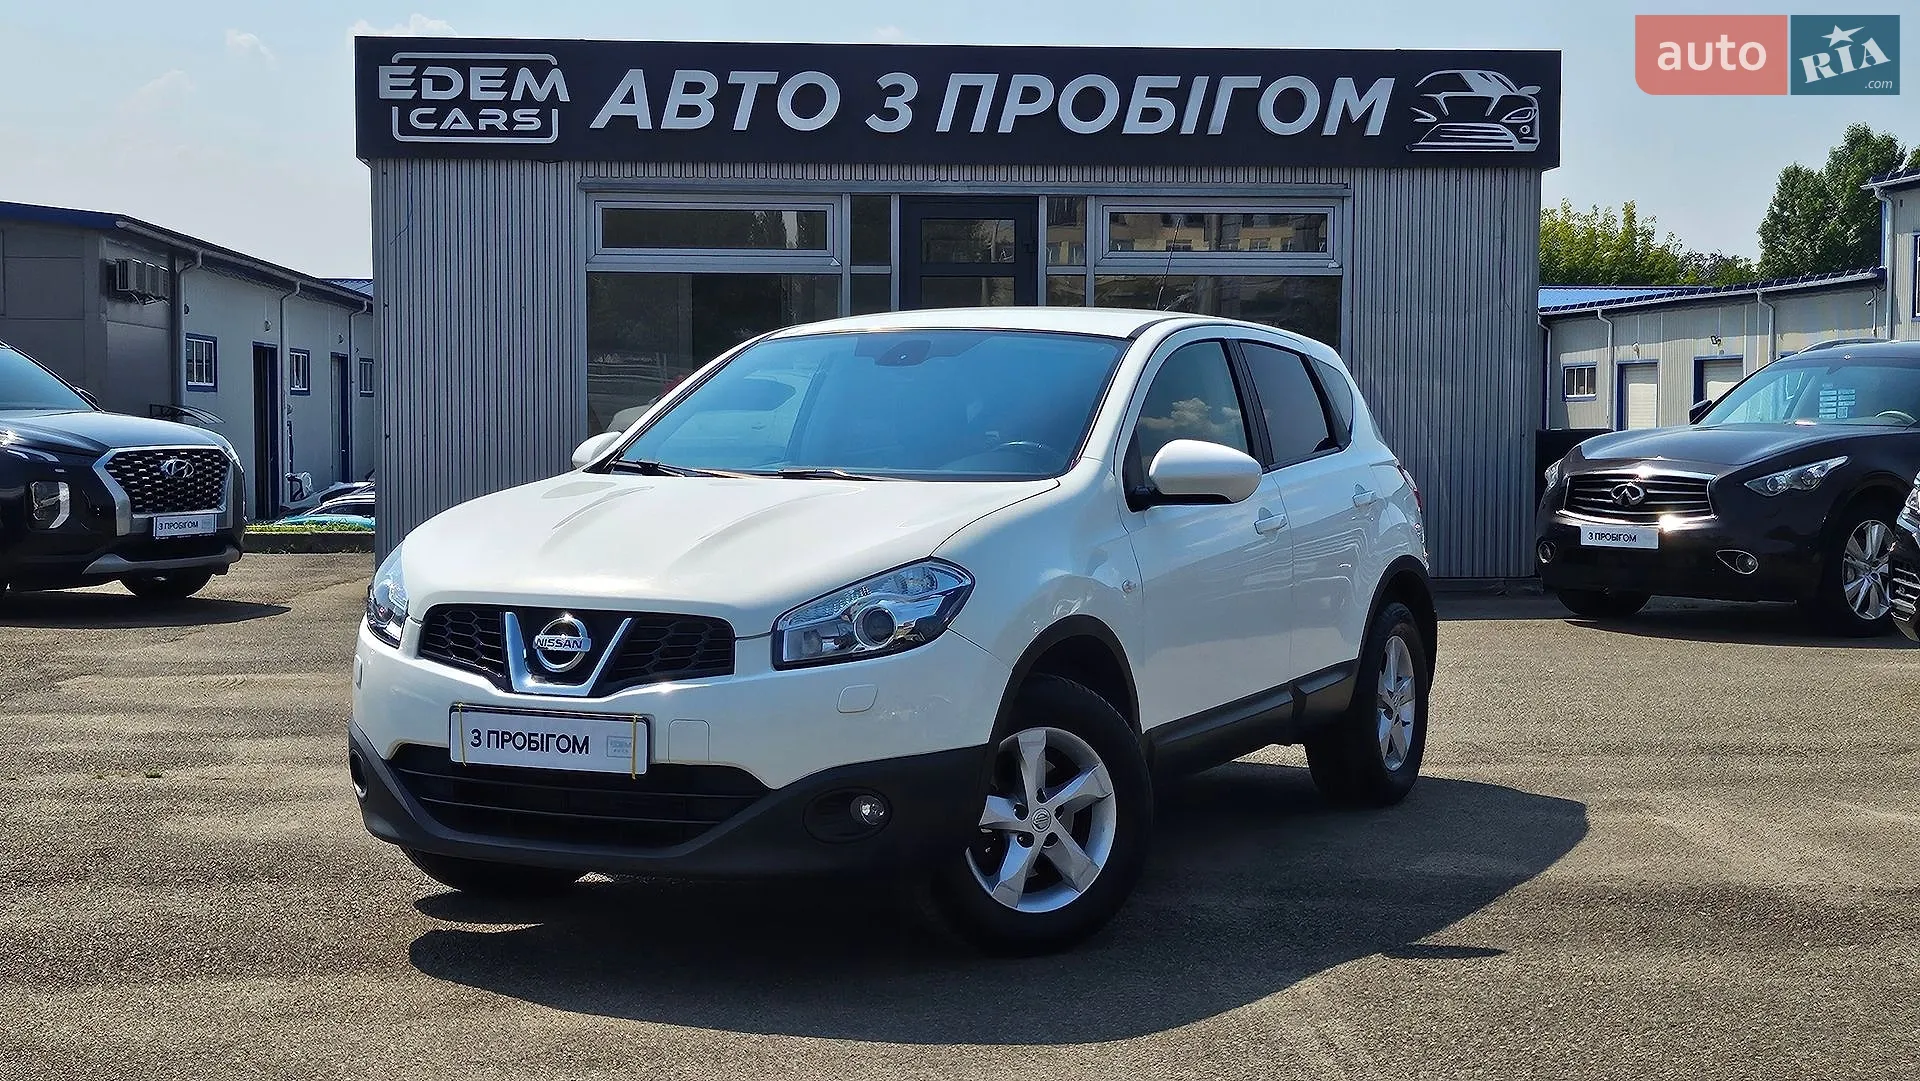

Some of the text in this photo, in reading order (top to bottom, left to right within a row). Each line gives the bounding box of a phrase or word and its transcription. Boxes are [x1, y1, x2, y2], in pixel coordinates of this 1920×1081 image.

[378, 65, 570, 103] EDEM
[589, 68, 1395, 138] АВТО З ПРОБІГОМ
[408, 107, 543, 131] CARS
[535, 638, 583, 650] NISSAN
[486, 729, 590, 755] ПРОБІГОМ
